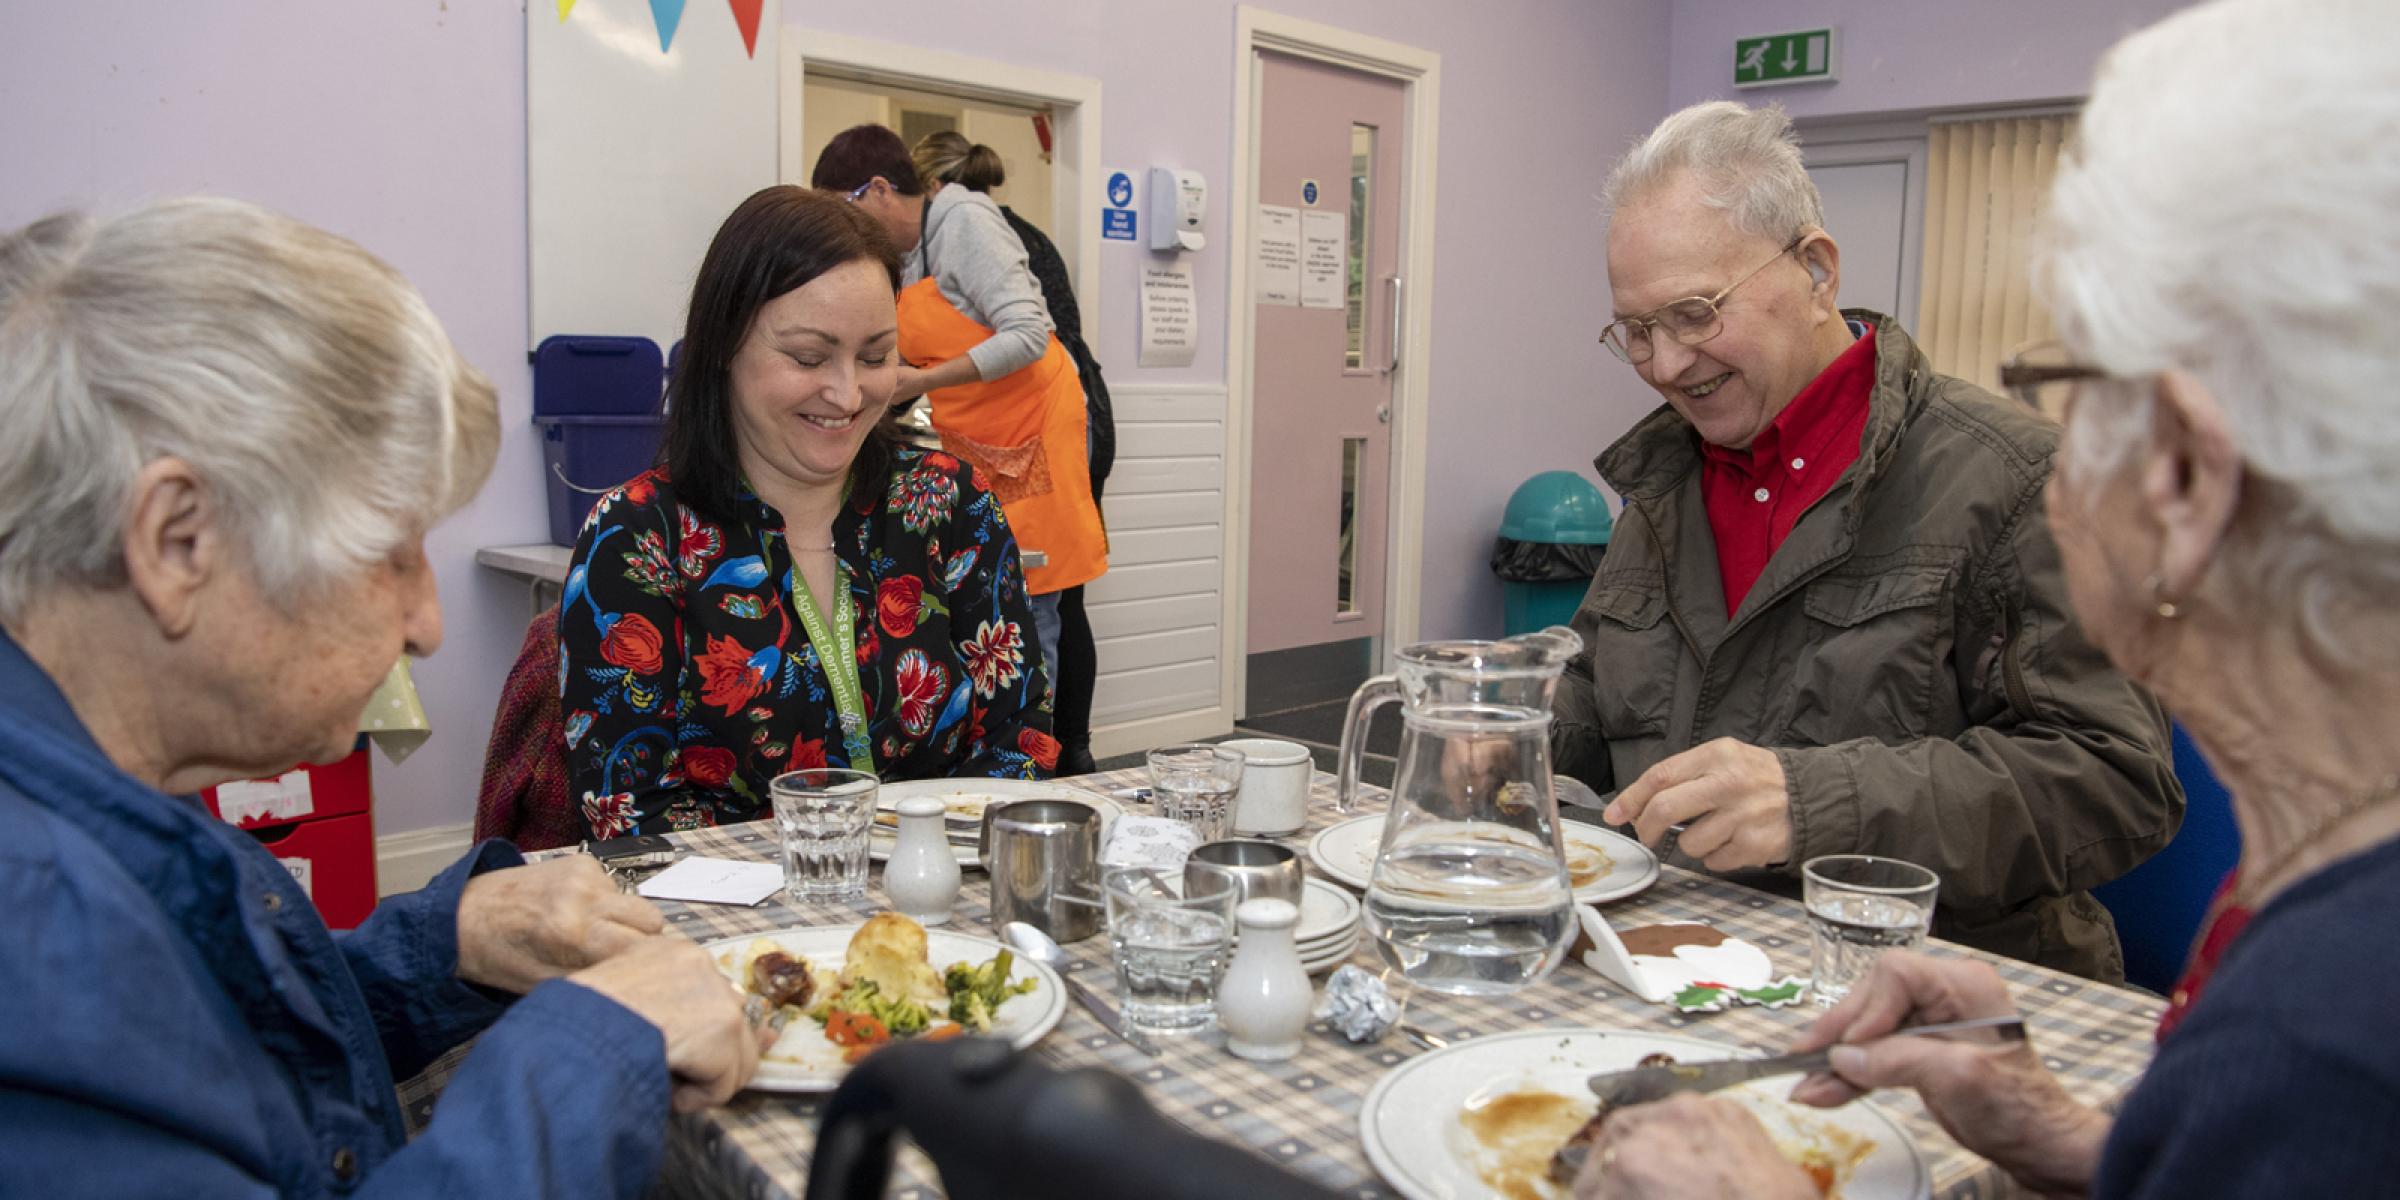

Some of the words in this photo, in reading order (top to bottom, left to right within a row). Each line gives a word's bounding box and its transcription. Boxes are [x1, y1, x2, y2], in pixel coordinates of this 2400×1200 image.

[837, 578, 851, 622] Society
[798, 594, 827, 642] Against
[820, 644, 852, 714] Dementia
